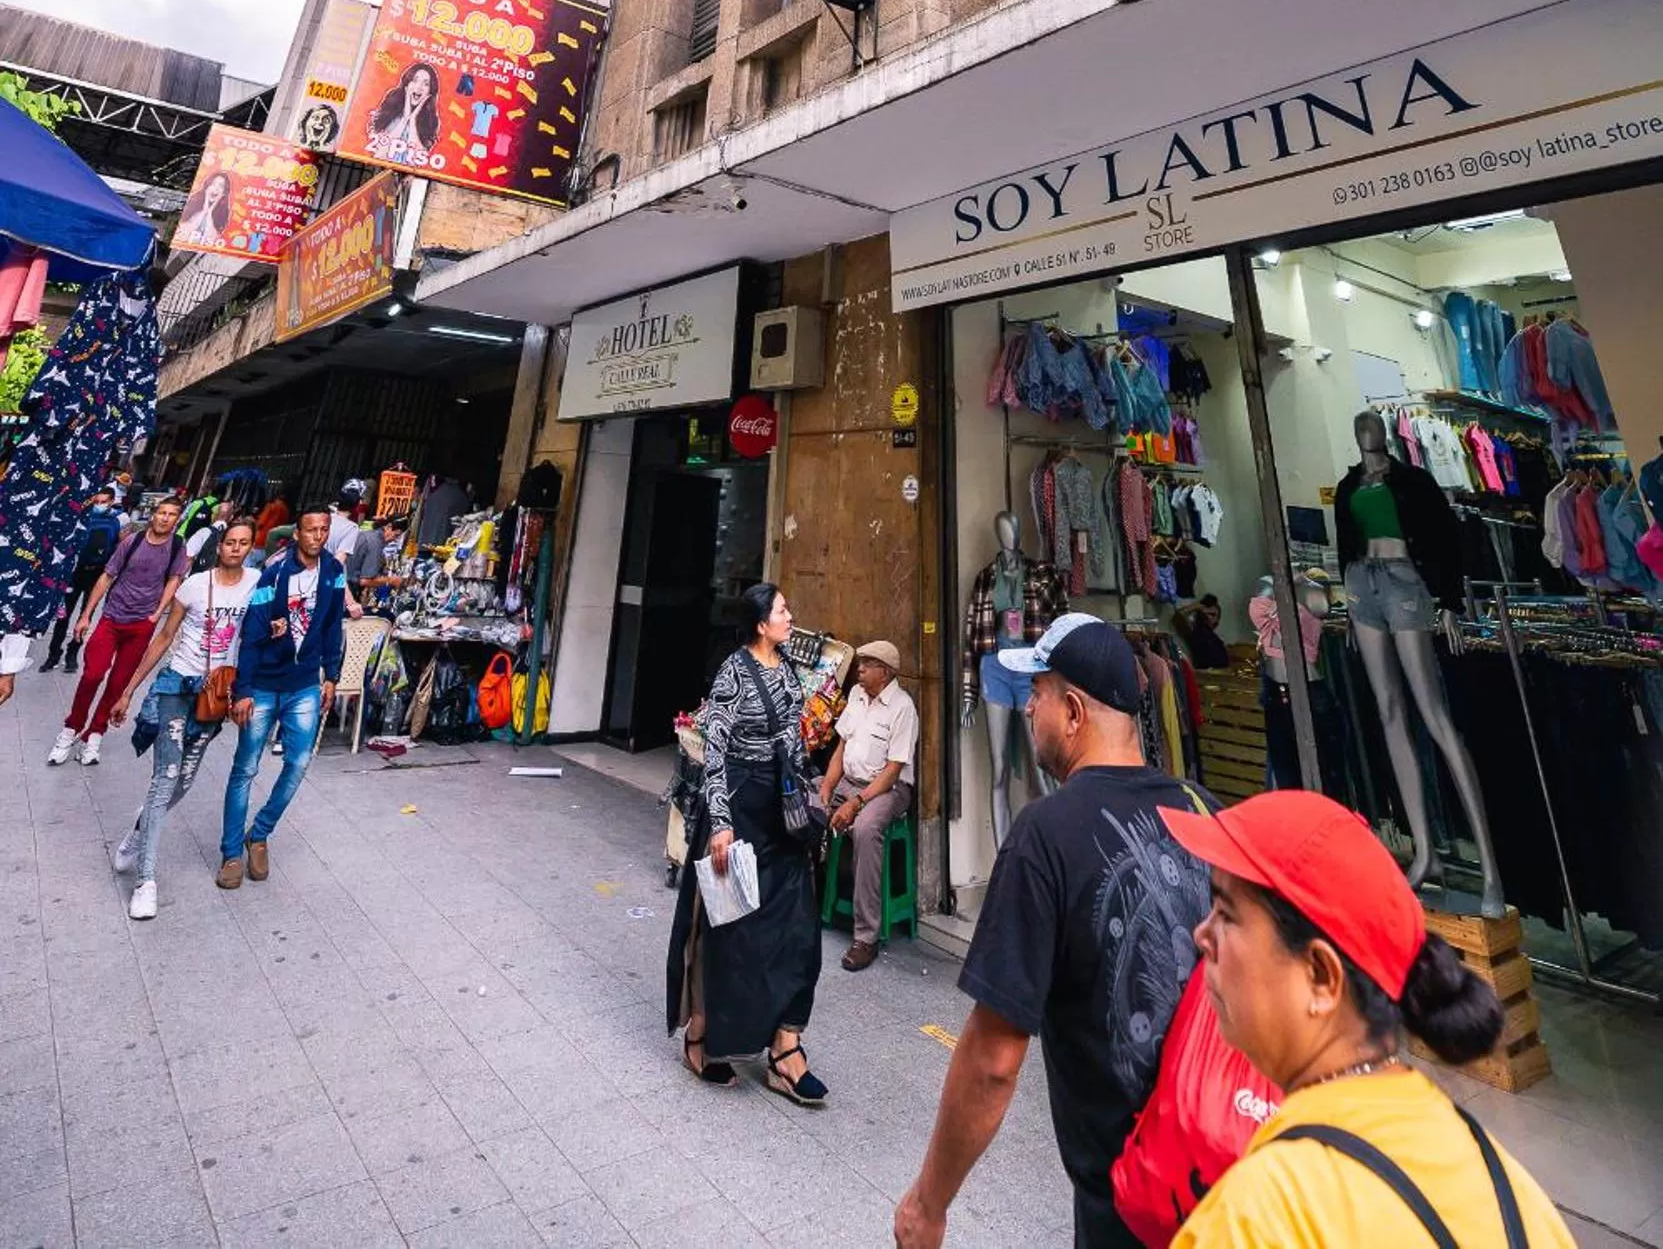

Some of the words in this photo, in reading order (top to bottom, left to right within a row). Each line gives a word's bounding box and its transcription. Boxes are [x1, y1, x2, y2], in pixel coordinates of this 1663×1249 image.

[412, 49, 446, 66] TODO
[223, 136, 274, 154] TODO
[954, 162, 1080, 246] SOY
[1098, 57, 1483, 205] LATINA
[1348, 180, 1376, 201] 301
[1380, 172, 1411, 194] 238
[1414, 162, 1456, 187] 0163
[1146, 192, 1188, 230] SL
[1144, 225, 1194, 251] STORE
[1024, 255, 1054, 274] CALLE
[611, 314, 672, 356] HOTEL
